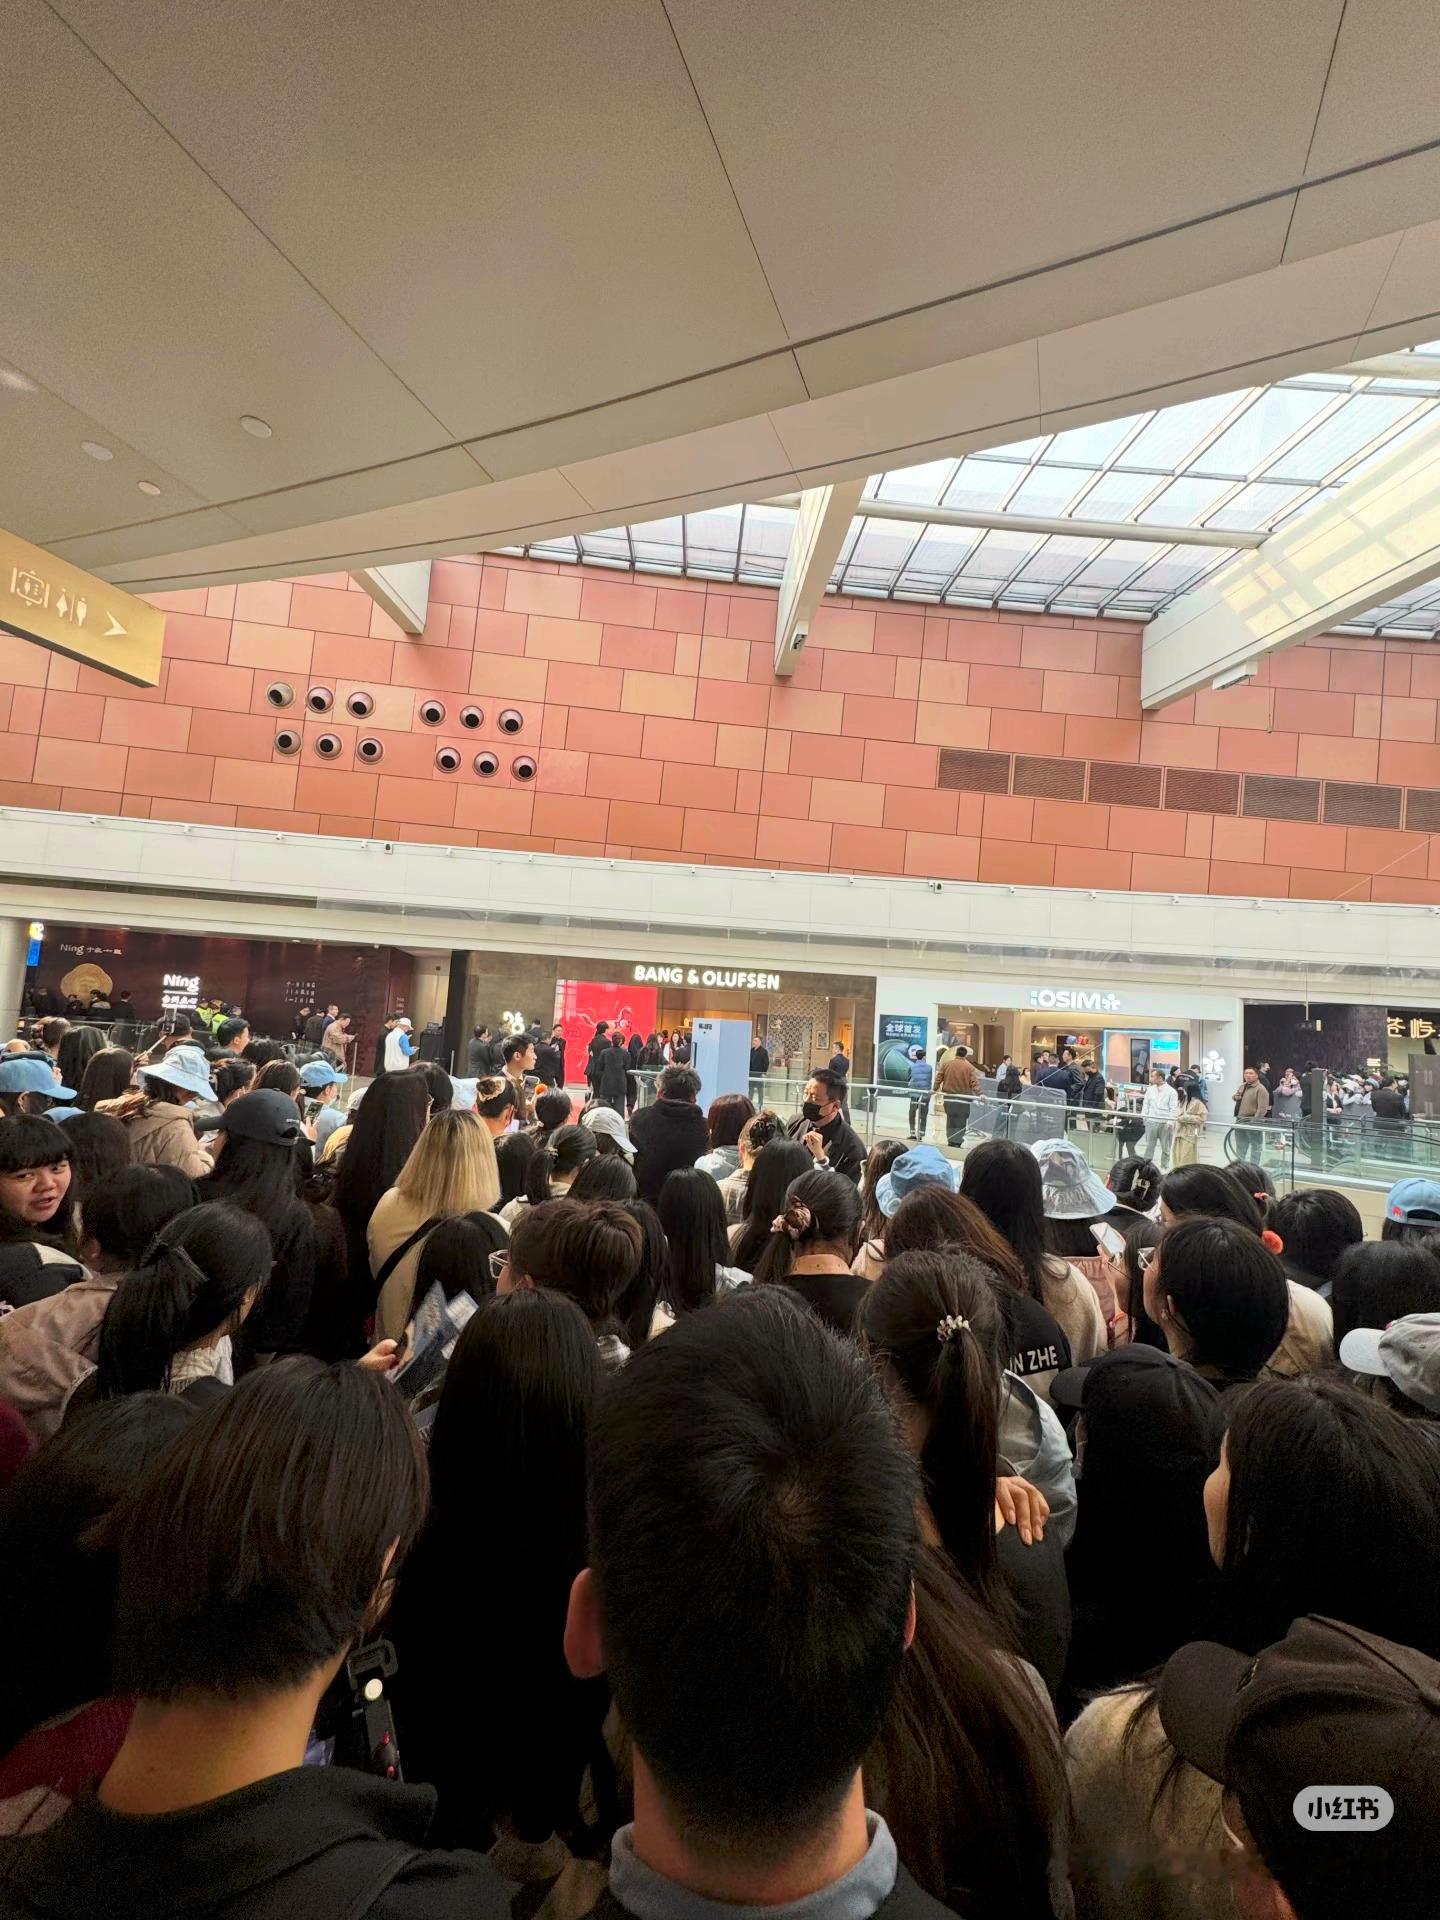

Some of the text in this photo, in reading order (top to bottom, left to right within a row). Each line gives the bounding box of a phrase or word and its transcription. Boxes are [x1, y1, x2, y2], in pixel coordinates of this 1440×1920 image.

[60, 943, 85, 956] Ning
[163, 973, 200, 992] Ning
[634, 965, 780, 990] BANG & OLUFSEN
[1038, 990, 1101, 1010] OSIM
[1386, 1016, 1440, 1039] 苍屿
[1026, 1345, 1059, 1371] ZHE
